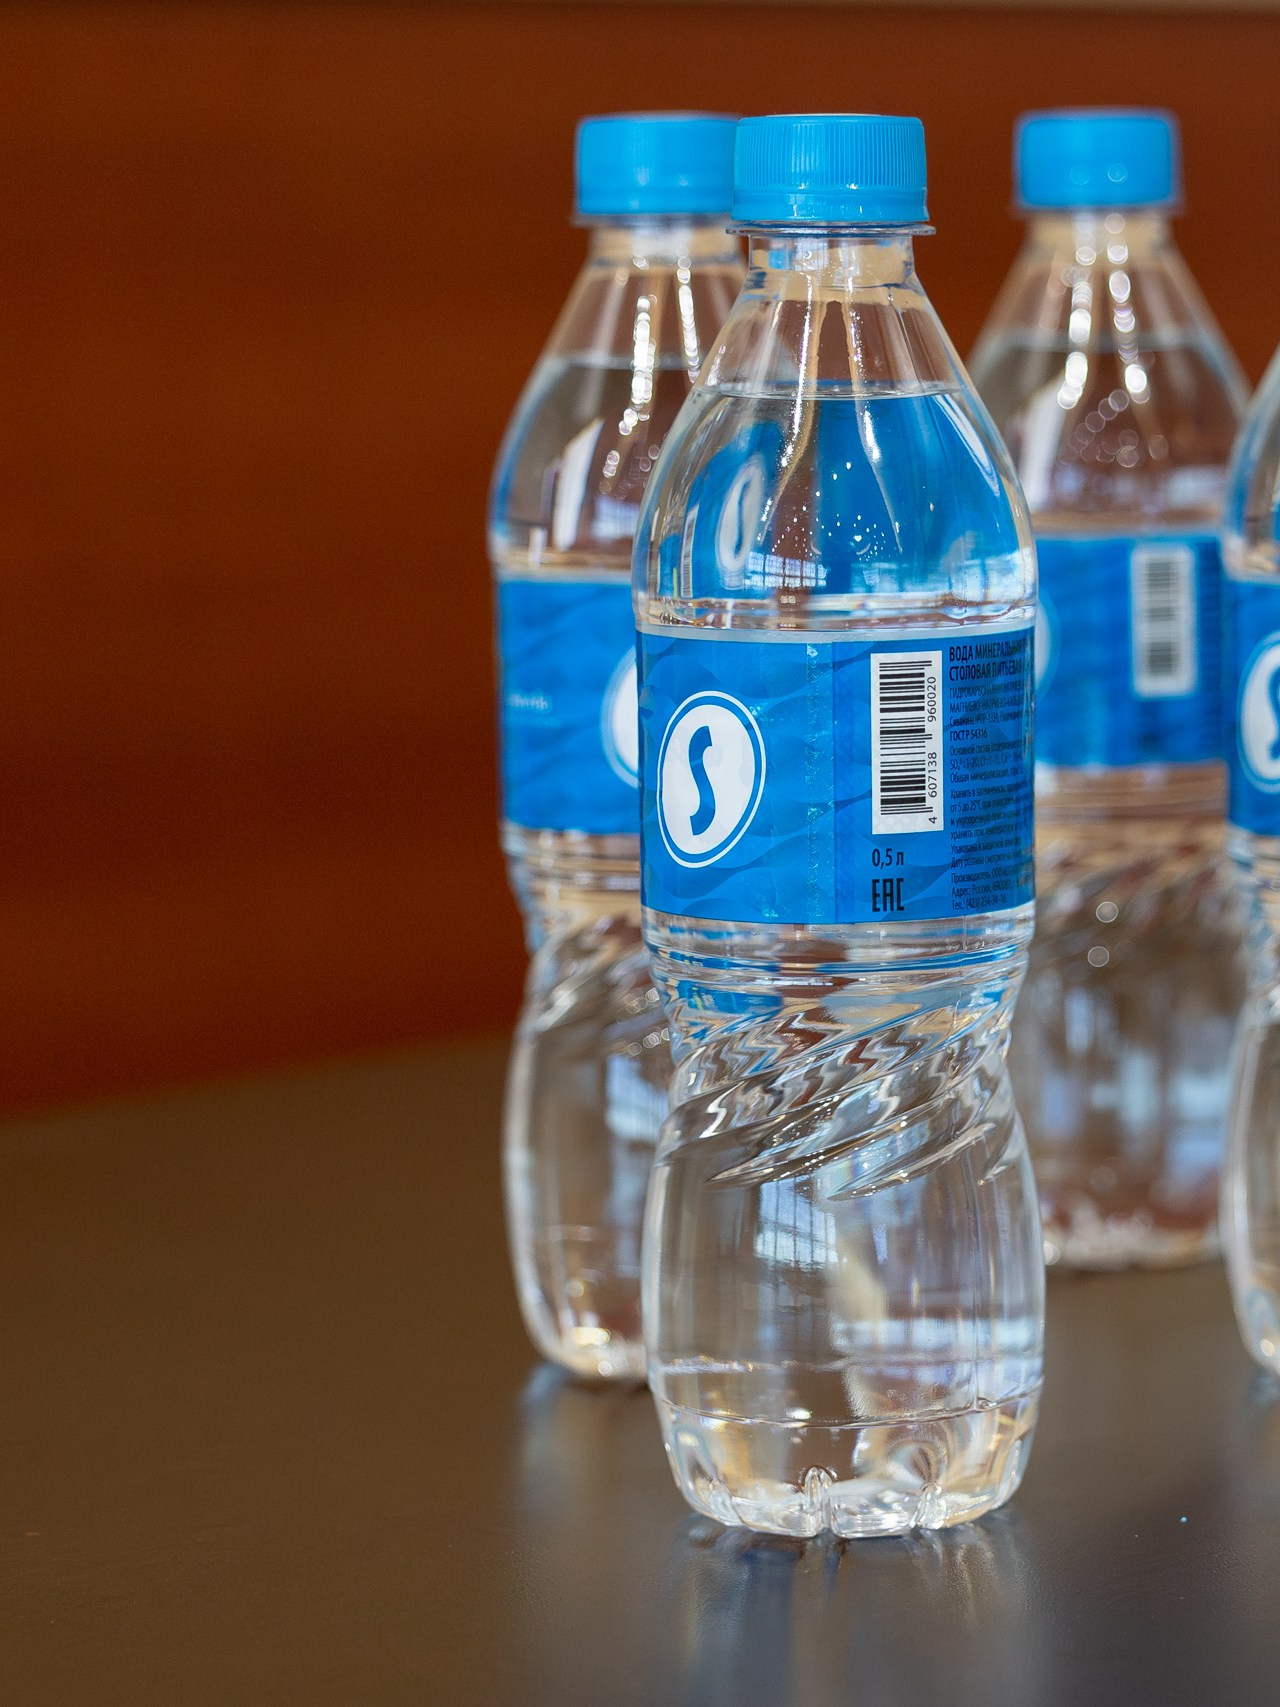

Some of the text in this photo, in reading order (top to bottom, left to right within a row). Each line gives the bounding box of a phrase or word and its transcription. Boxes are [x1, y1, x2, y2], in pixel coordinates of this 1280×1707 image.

[949, 645, 973, 663] ВОДА
[949, 663, 991, 681] СТОЛОВАЯ
[950, 729, 965, 742] ГОСТ
[970, 728, 988, 740] 54316
[926, 675, 938, 825] 4 607138 960020
[871, 848, 905, 867] 0,5 л
